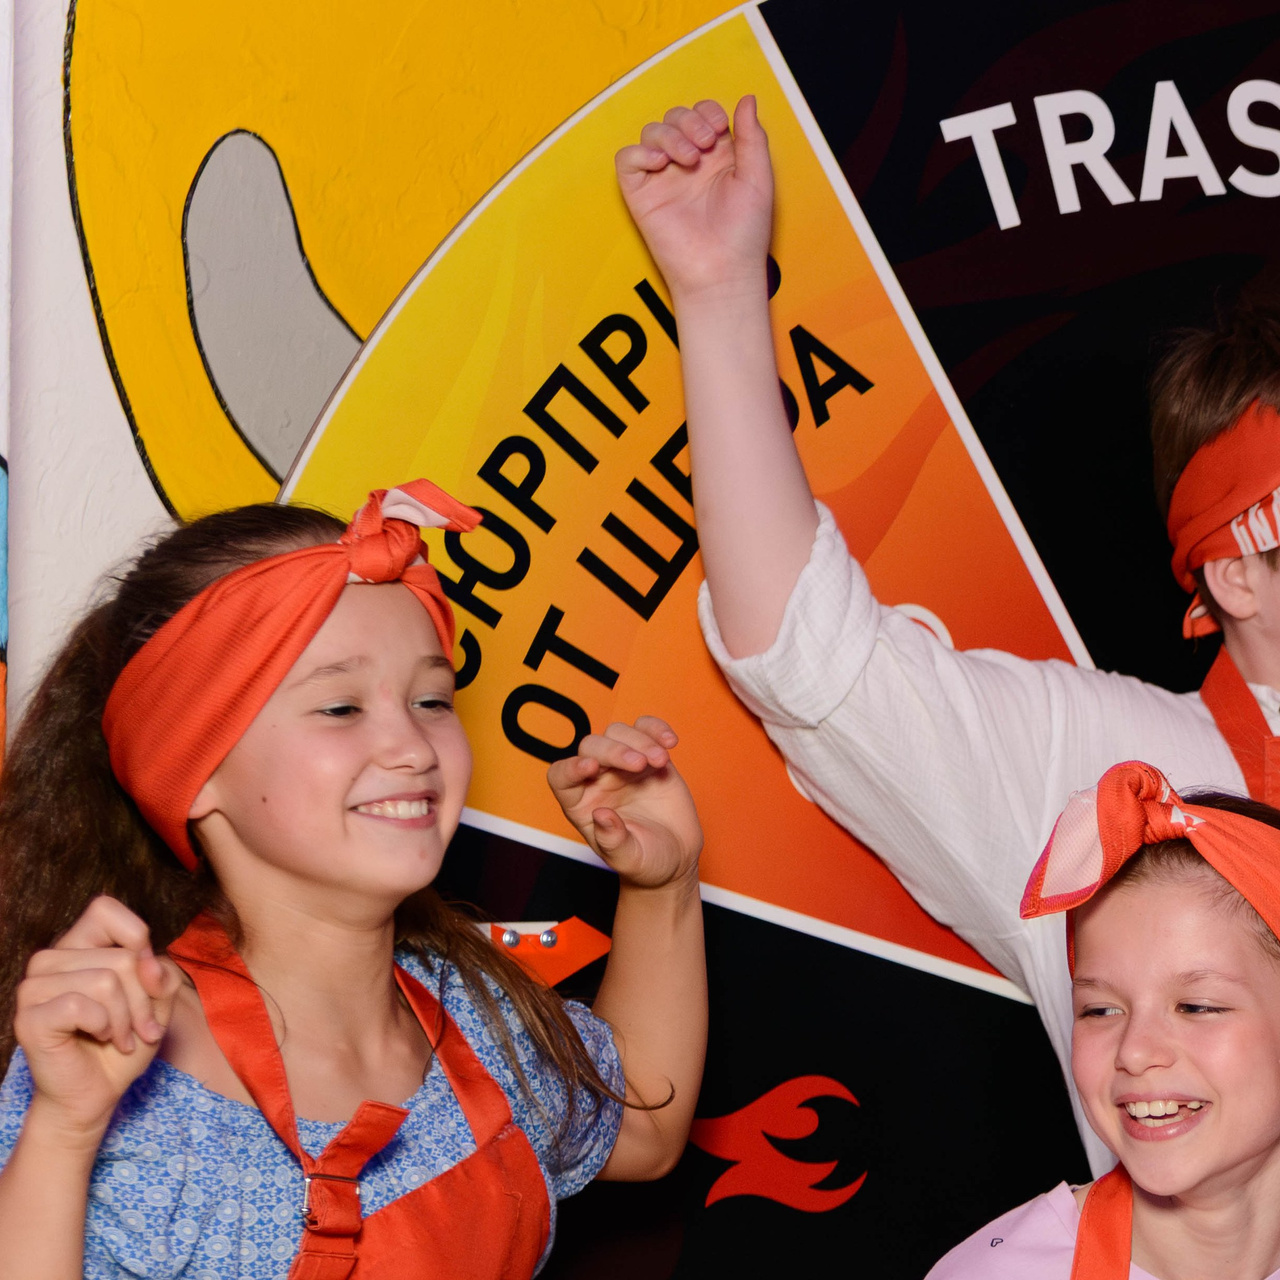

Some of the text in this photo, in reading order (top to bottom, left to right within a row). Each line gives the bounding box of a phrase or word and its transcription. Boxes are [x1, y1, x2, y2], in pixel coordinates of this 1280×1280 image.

[440, 252, 781, 691] ЮРПР
[501, 323, 875, 764] ОТ ША
